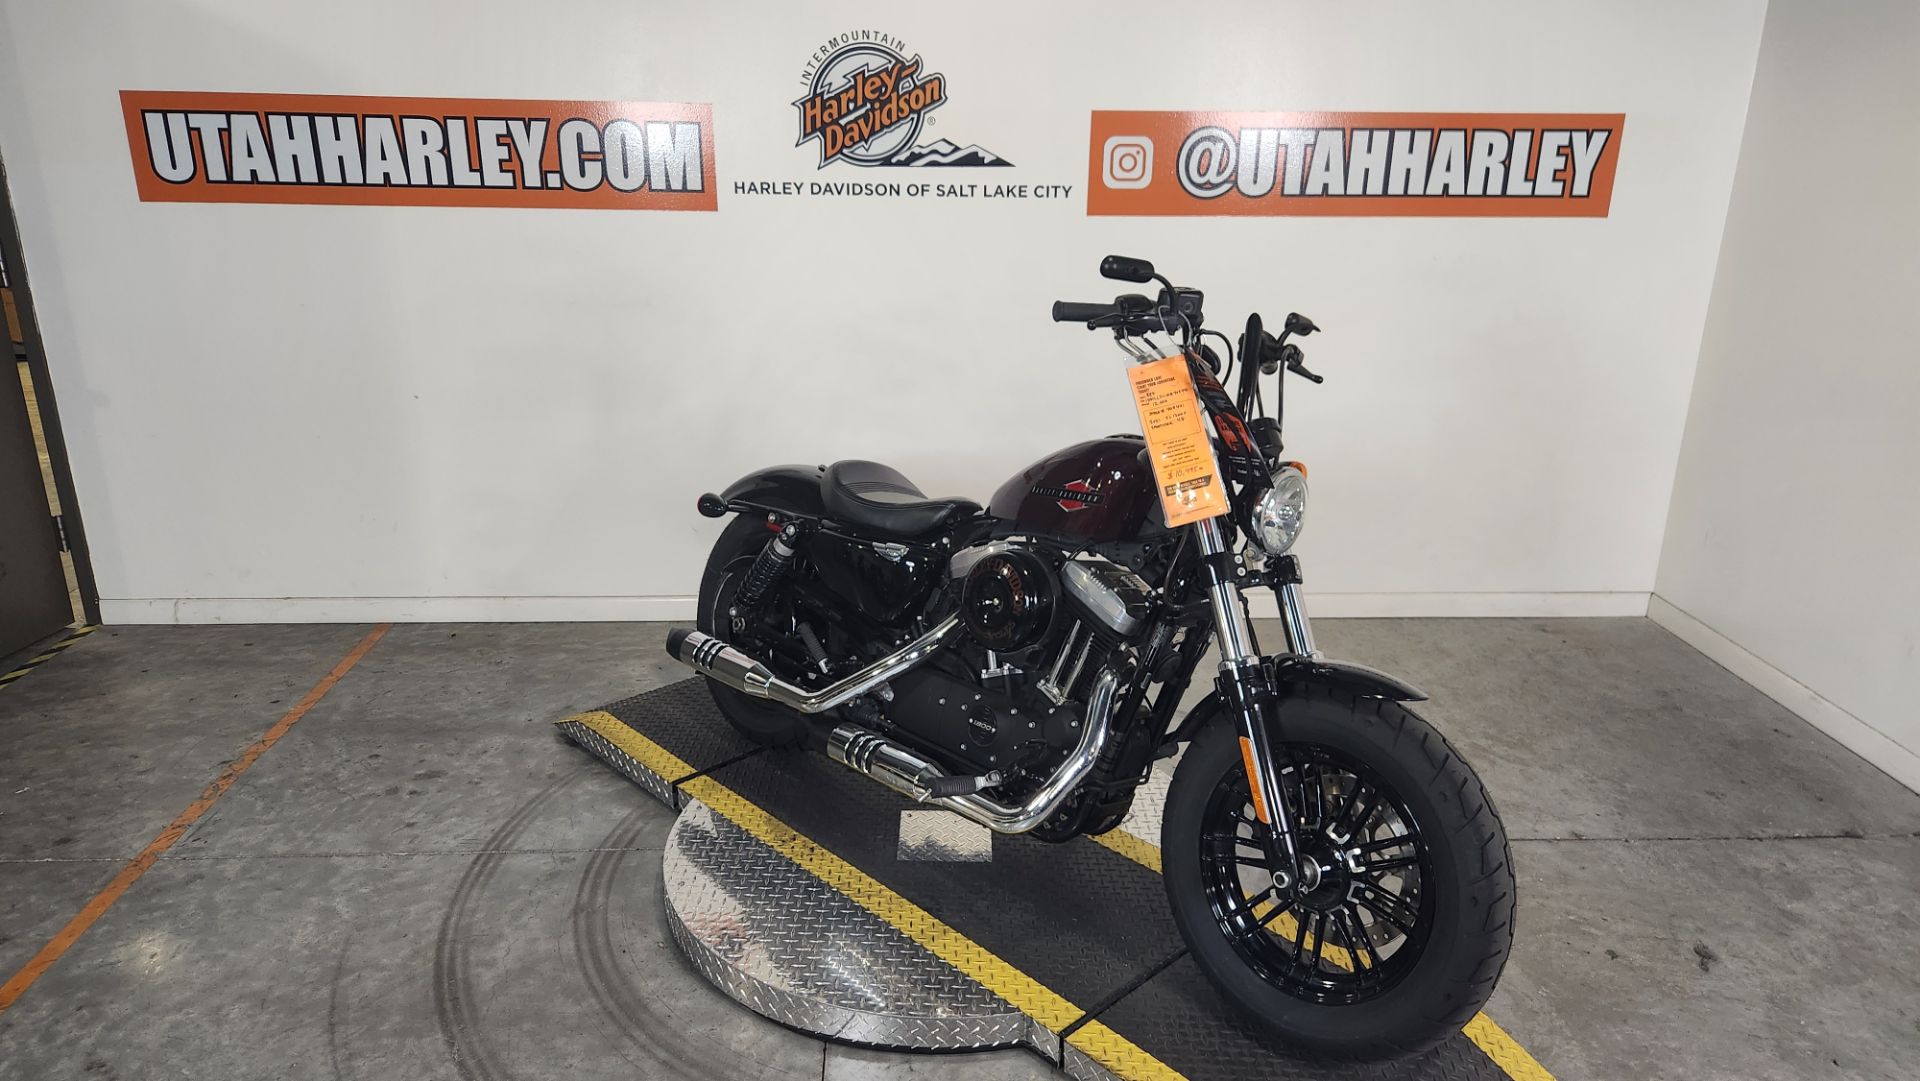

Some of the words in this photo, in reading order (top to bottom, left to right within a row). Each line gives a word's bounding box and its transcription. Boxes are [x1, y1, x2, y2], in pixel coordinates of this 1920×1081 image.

[799, 29, 906, 87] INTERMOUNTAIN
[141, 109, 705, 193] UTAHHARLEY.COM
[825, 78, 941, 160] Davidson
[733, 181, 804, 196] HARLEY
[810, 182, 901, 197] DAVIDSON
[906, 183, 931, 198] OF
[936, 184, 977, 199] SALT
[983, 184, 1028, 199] LAKE
[1033, 185, 1073, 199] CITY
[1176, 125, 1613, 199] @UTAHHARLEY
